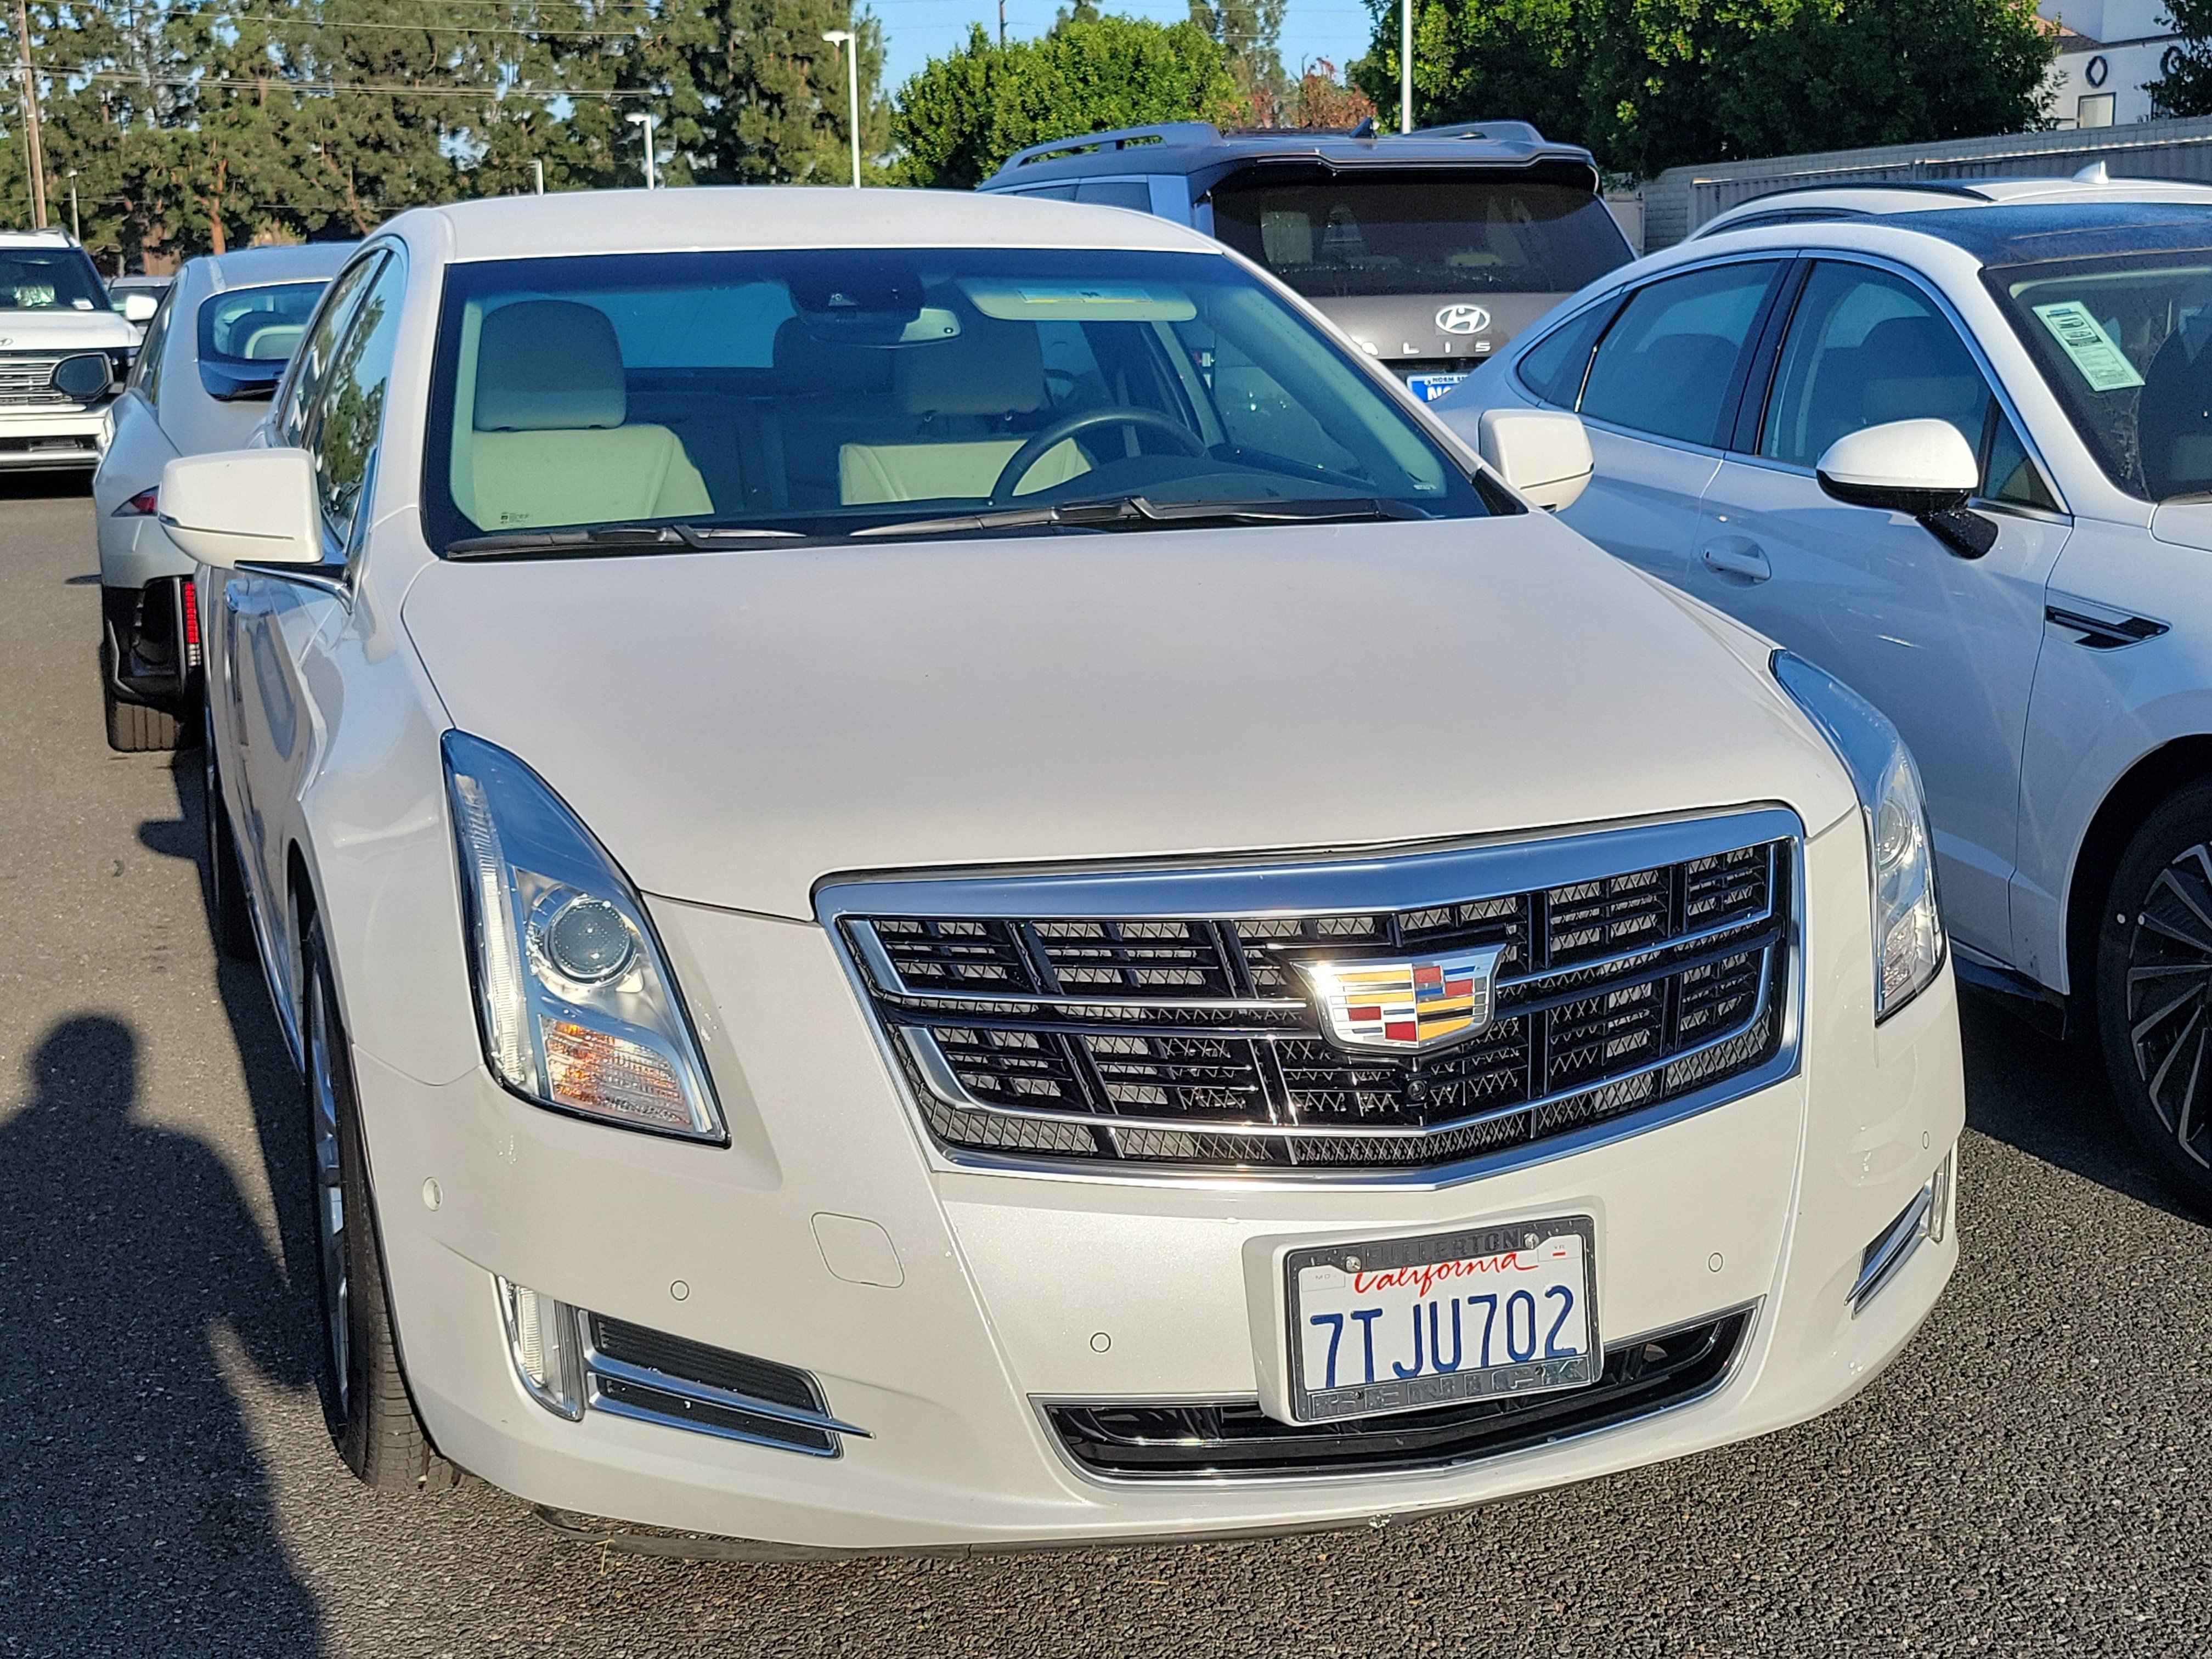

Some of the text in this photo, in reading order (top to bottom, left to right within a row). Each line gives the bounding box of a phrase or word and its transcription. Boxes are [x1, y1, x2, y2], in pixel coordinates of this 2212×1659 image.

[1365, 1228, 1521, 1264] FULLERTON
[1355, 1251, 1539, 1297] California
[1310, 1285, 1576, 1389] 7TJU702
